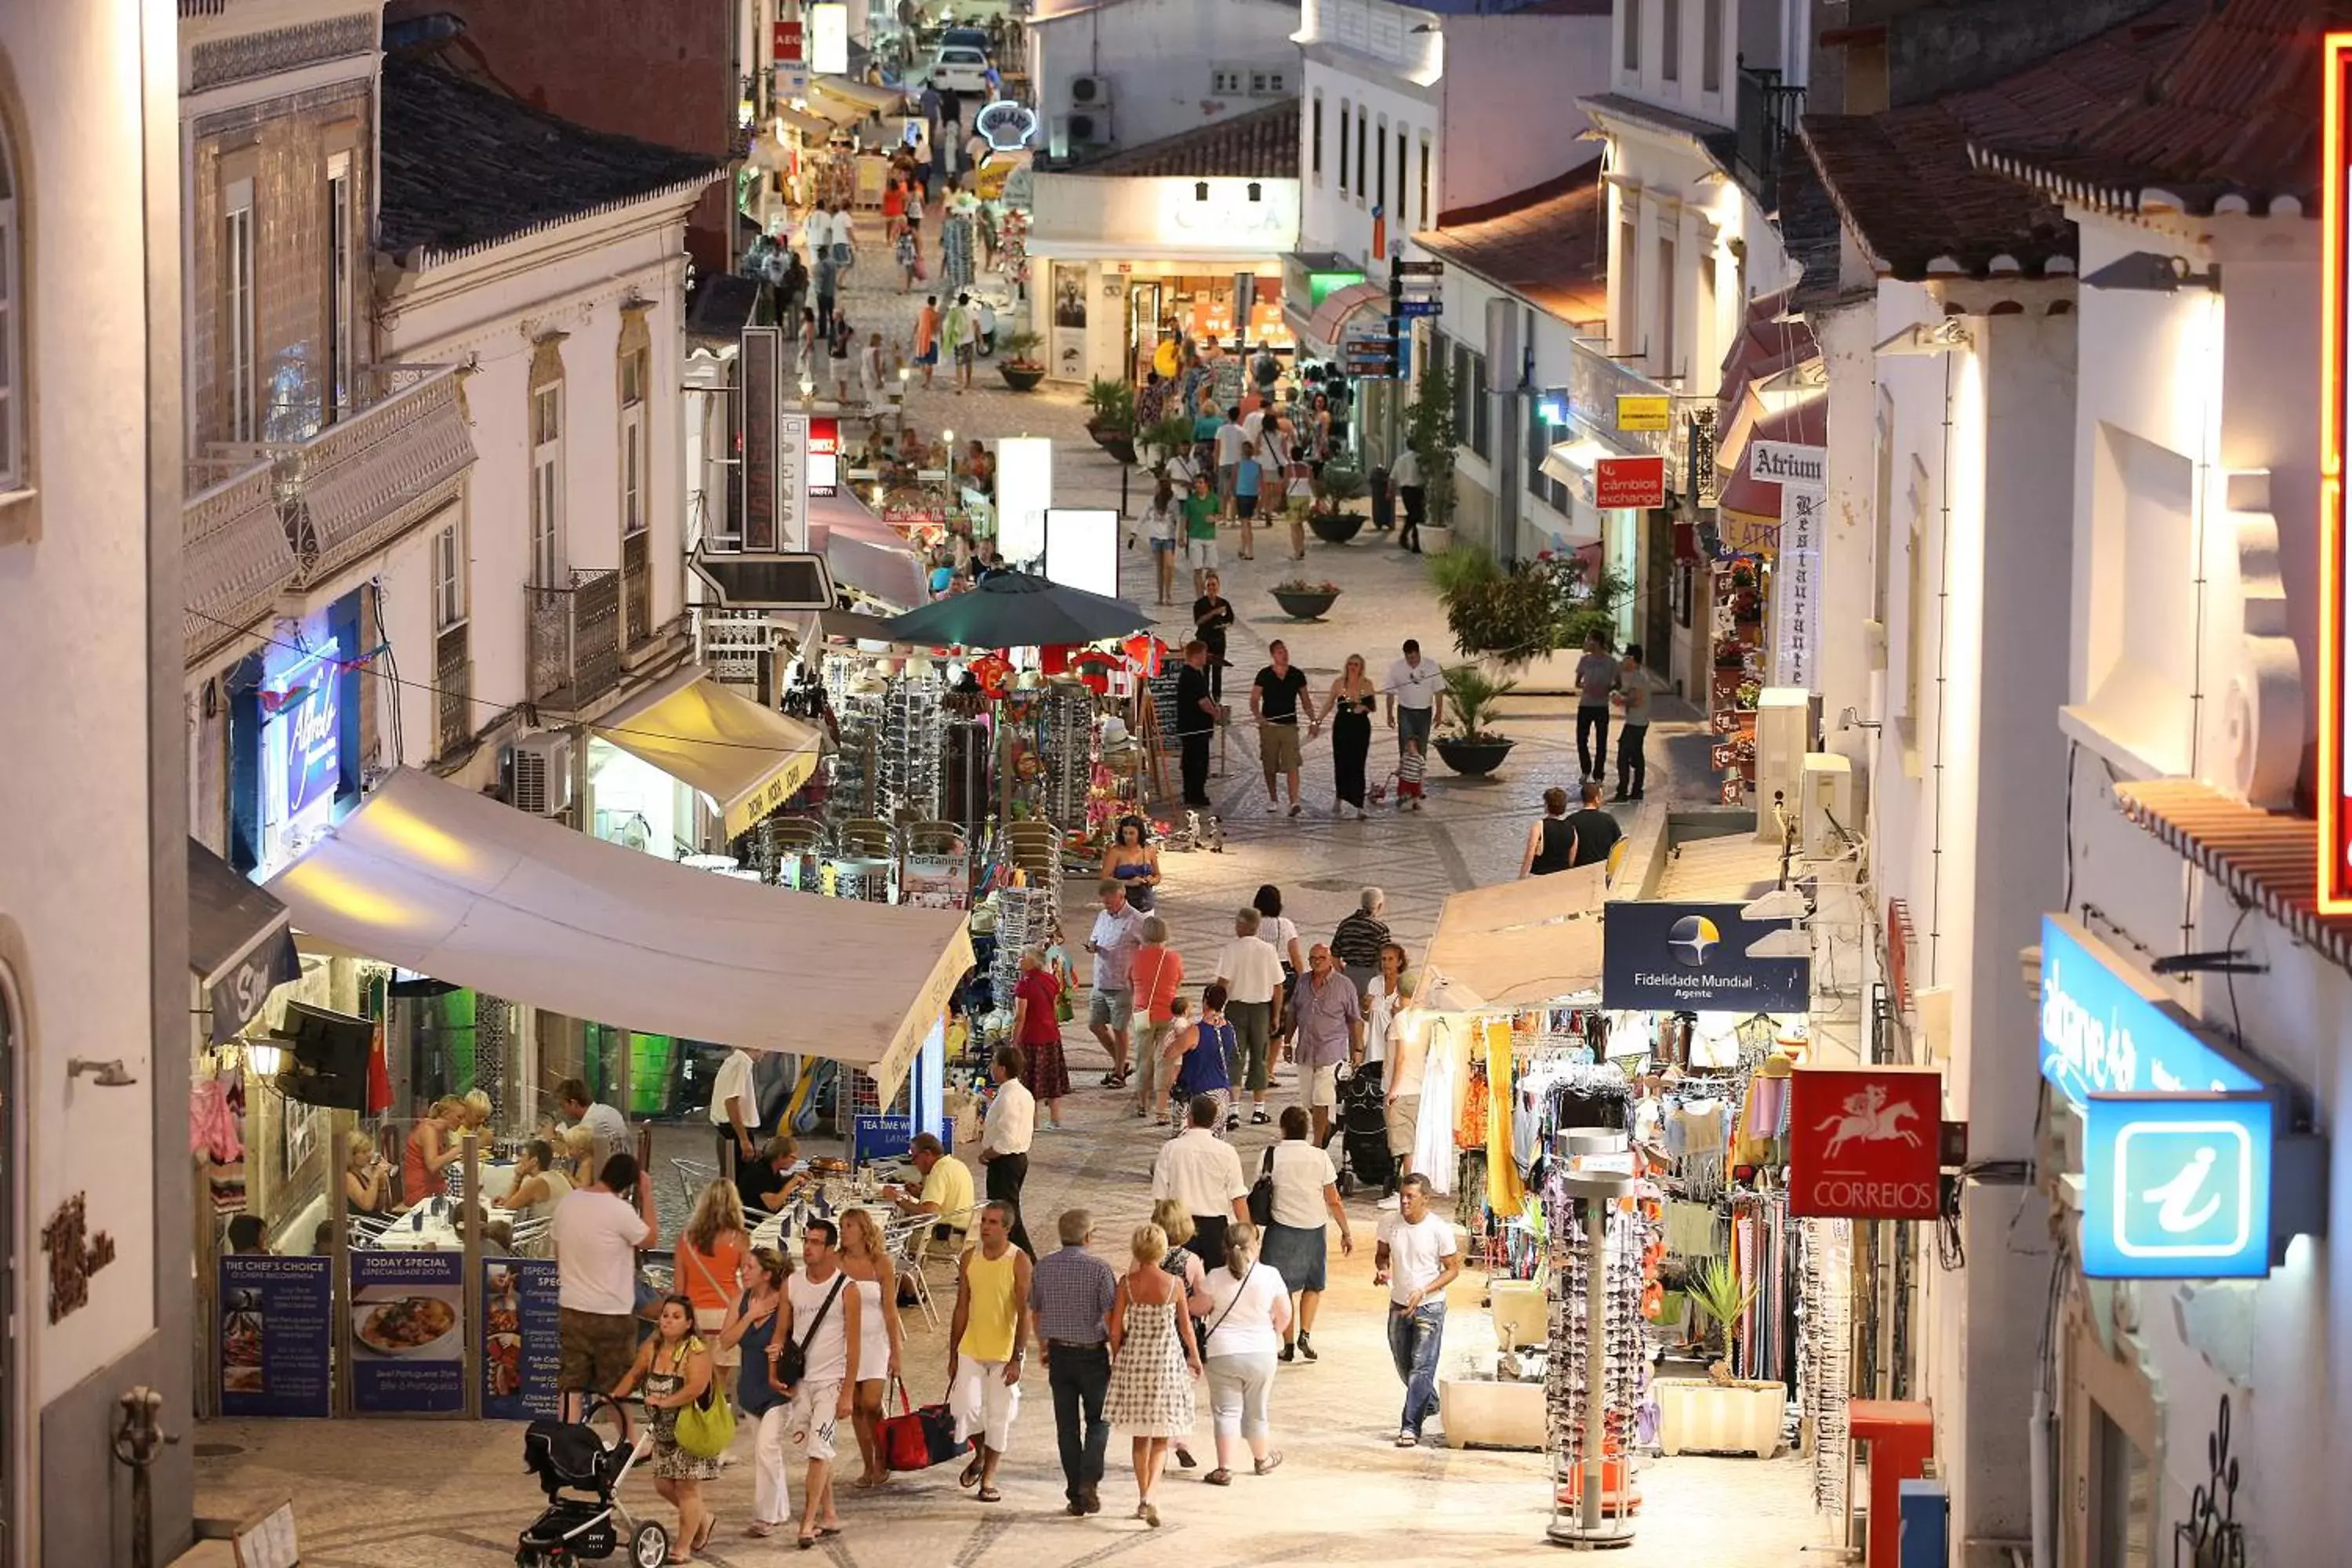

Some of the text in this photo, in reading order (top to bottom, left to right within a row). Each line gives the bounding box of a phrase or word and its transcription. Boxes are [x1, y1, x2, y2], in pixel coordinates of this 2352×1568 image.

[1755, 448, 1821, 480] Atrium
[1599, 492, 1661, 506] exchange
[1791, 495, 1813, 684] Restaurante
[1635, 973, 1752, 988] Fidelidade Mundial
[1674, 989, 1713, 1000] Agente
[862, 1120, 877, 1130] TEA
[1813, 1181, 1933, 1210] CORREIOS
[226, 1261, 244, 1271] THE
[282, 1262, 325, 1272] CHOICE
[366, 1258, 448, 1268] TODAY SPECIAL
